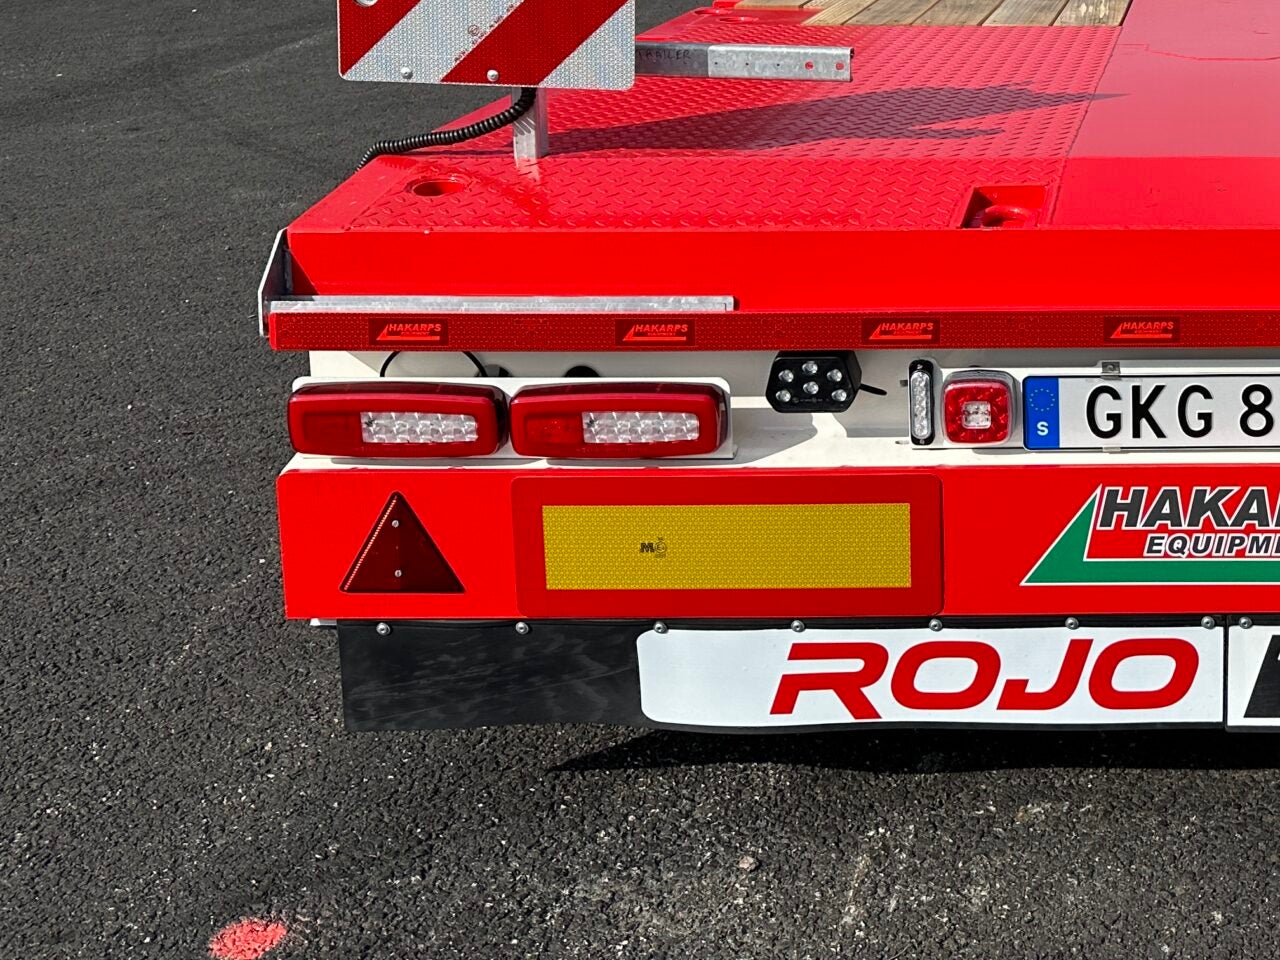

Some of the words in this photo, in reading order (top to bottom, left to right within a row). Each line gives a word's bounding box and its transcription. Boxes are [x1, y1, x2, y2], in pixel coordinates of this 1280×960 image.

[389, 323, 442, 332] HAKARPS
[635, 324, 688, 332] HAKARPS
[881, 322, 934, 331] HAKARPS
[1122, 321, 1174, 330] HAKARPS
[1085, 384, 1214, 439] GKG
[1037, 421, 1049, 436] S
[769, 637, 1200, 720] ROJO
